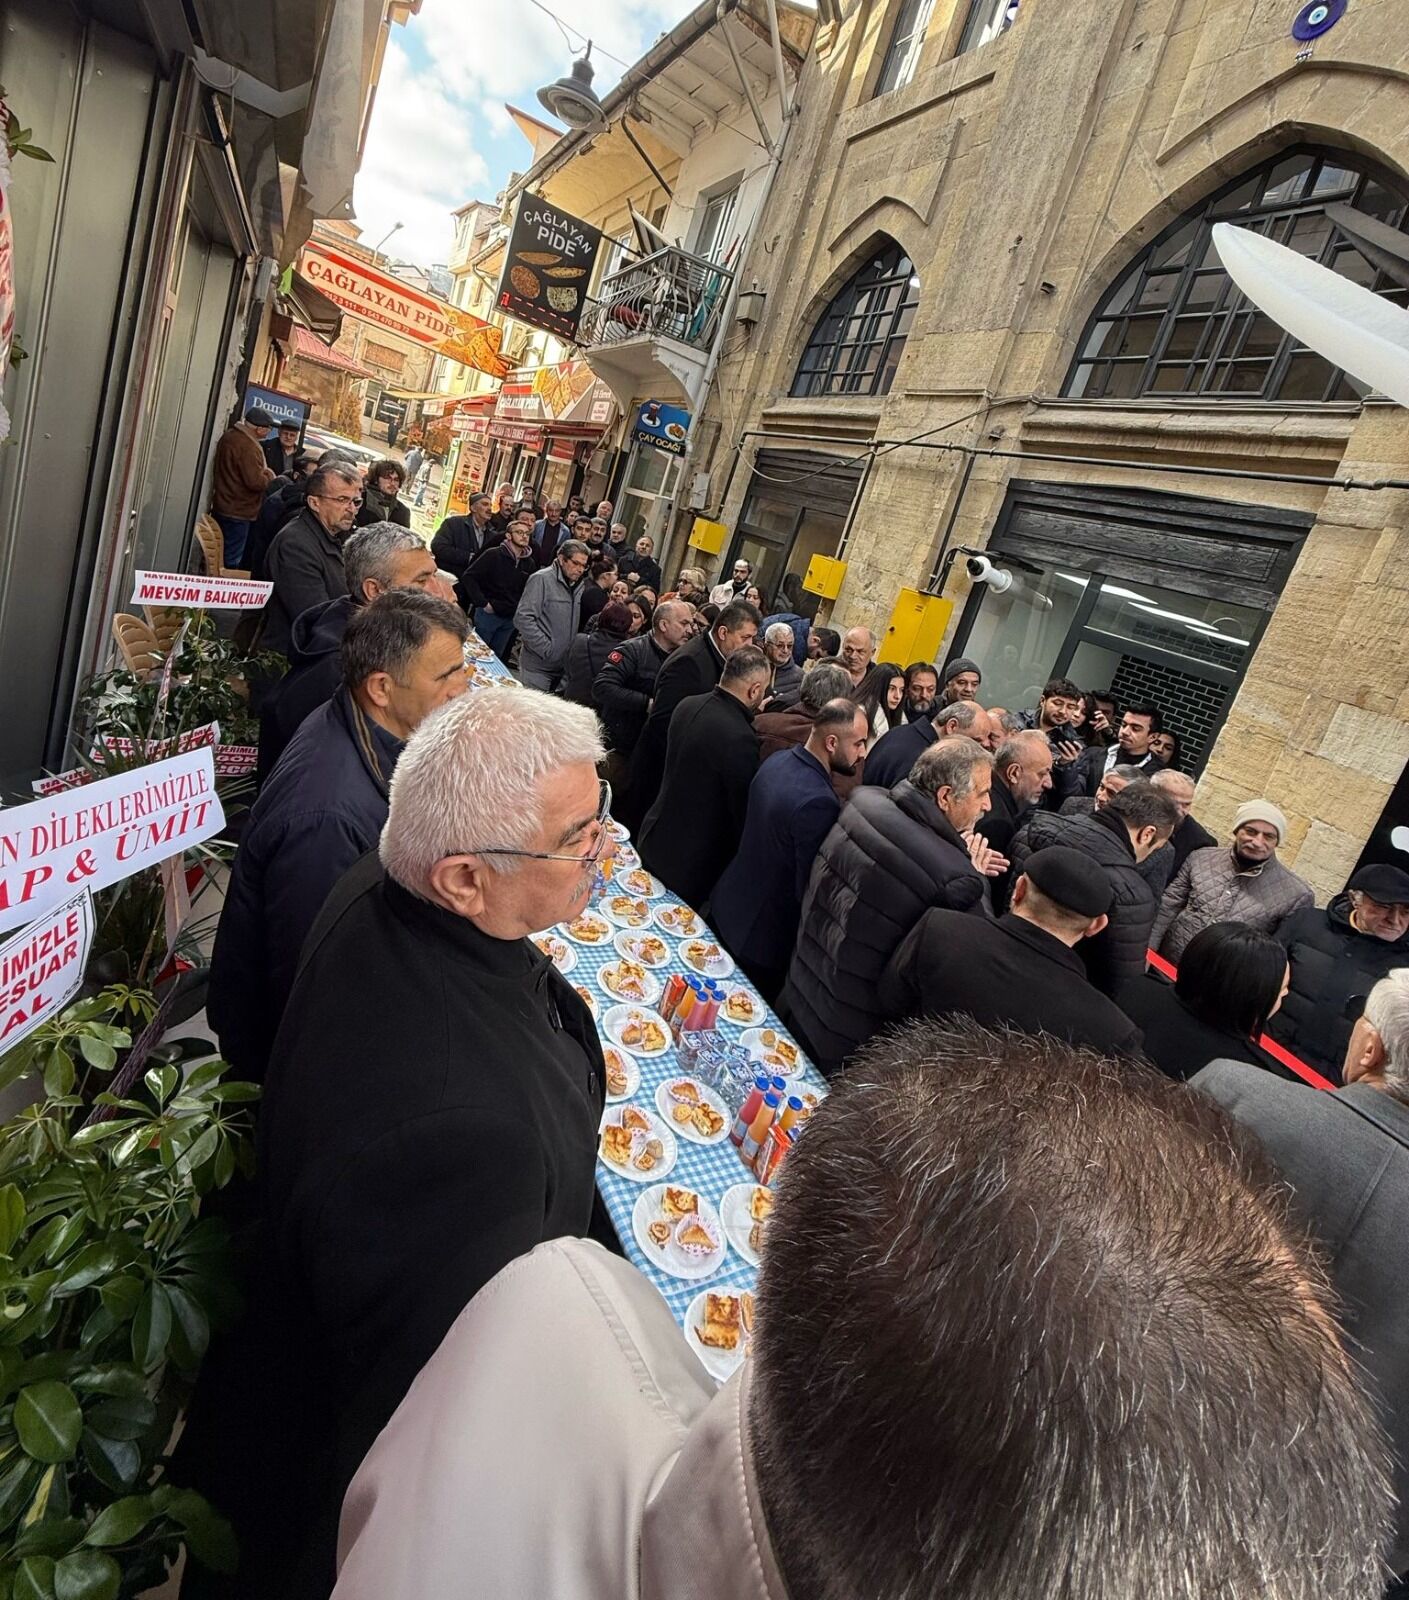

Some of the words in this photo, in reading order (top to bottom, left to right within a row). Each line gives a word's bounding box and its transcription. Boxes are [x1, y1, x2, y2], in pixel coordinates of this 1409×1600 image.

[523, 209, 592, 254] ÇAĞLAYAN
[537, 227, 578, 257] PİDE
[306, 260, 410, 318] ÇAĞLAYAN
[414, 312, 455, 338] PİDE
[253, 396, 296, 418] Damla
[655, 438, 681, 453] OCAĞI
[144, 573, 183, 582] HAYIRLI
[184, 576, 213, 585] OLSUN
[139, 584, 201, 602] MEVSİM
[203, 590, 267, 607] BALIKÇILIK
[30, 768, 209, 858] DİLEKLERİMİZLE
[66, 849, 98, 883] &
[115, 799, 212, 861] ÜMİT
